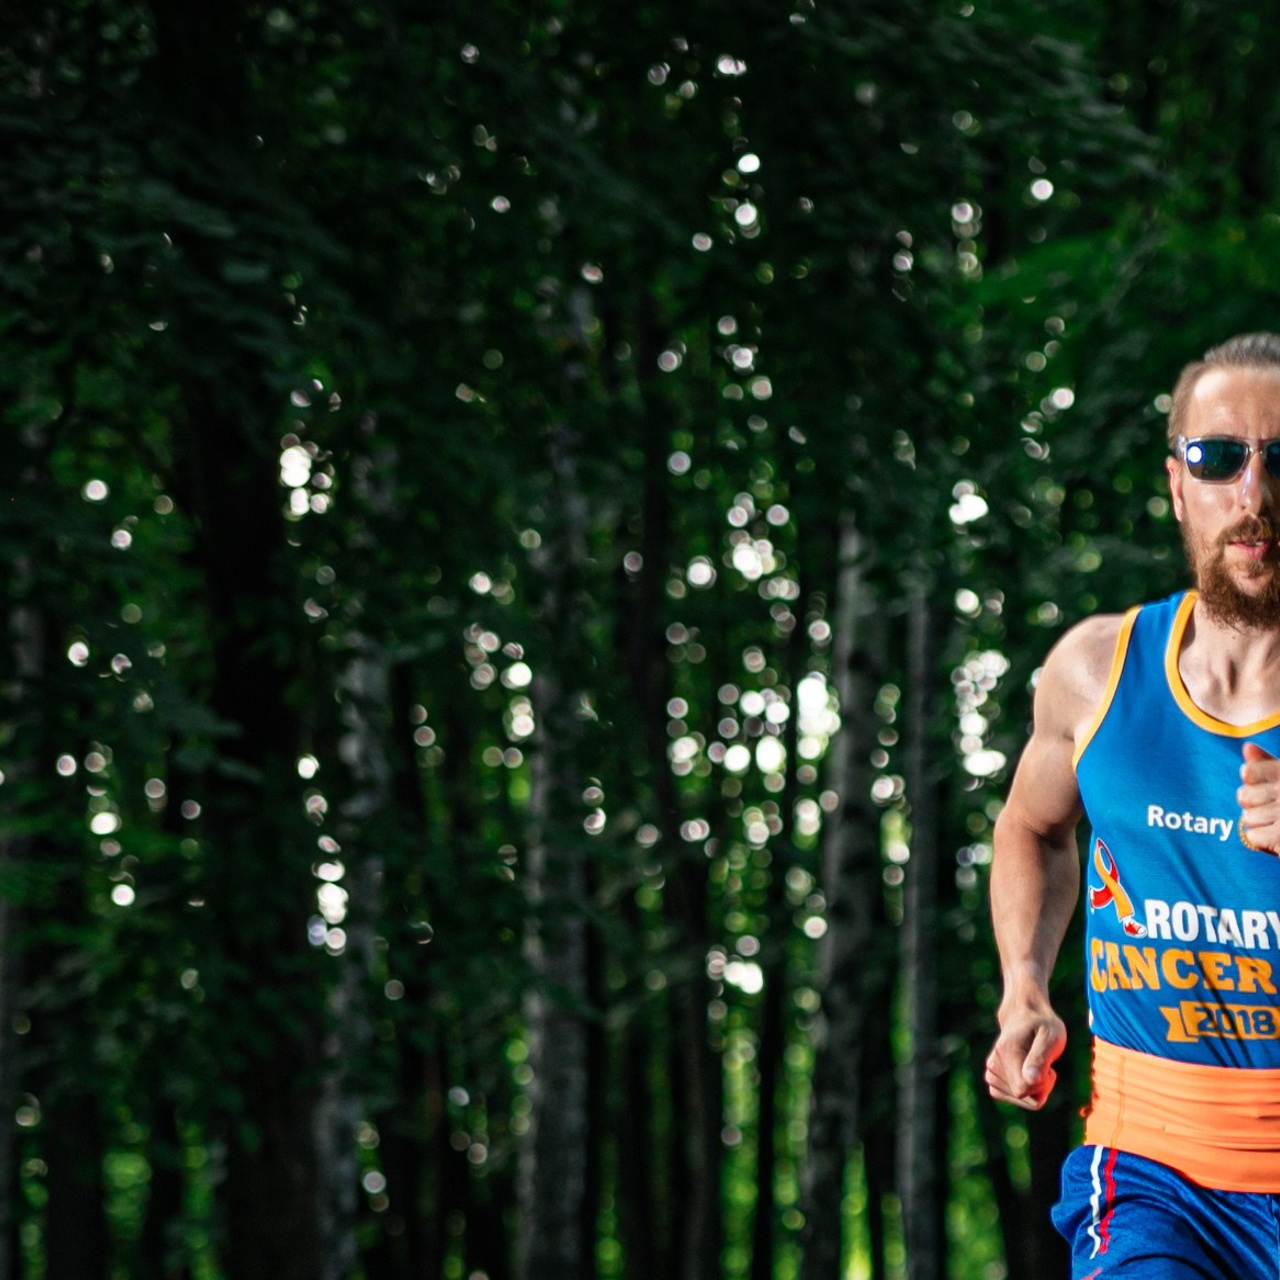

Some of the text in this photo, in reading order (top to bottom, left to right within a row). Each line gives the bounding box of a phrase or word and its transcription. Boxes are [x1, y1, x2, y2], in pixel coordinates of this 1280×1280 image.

[1147, 804, 1234, 842] Rotary
[1090, 938, 1278, 995] CANCER
[1195, 1005, 1276, 1036] 2018
